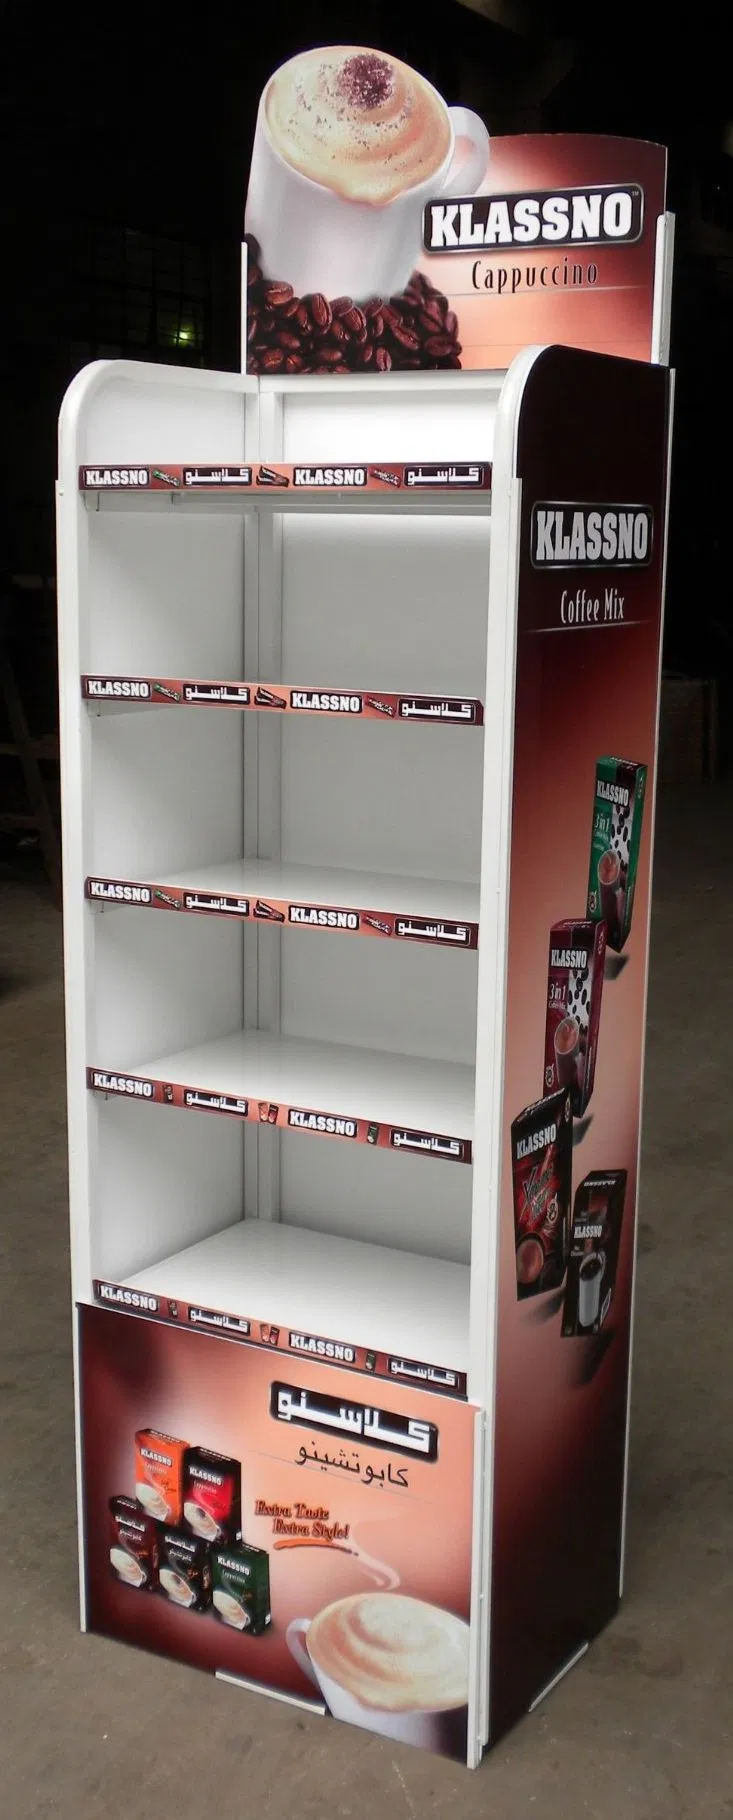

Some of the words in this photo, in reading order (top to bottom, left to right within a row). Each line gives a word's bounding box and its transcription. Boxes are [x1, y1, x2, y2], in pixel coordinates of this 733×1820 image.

[430, 191, 632, 248] KLASSNO
[471, 257, 598, 294] Cappuccino
[85, 470, 148, 485] KLASSNO
[294, 468, 365, 486] KLASSNO
[536, 510, 648, 560] KLASSNO
[560, 589, 600, 624] Coffee
[603, 587, 625, 621] Mix
[87, 680, 149, 697] KLASSNO
[291, 692, 360, 712] KLASSNO
[596, 779, 629, 806] KLASSNO
[90, 881, 151, 903] KLASSNO
[290, 907, 358, 929] KLASSNO
[551, 949, 587, 969] KLASSNO
[549, 983, 554, 999] 3
[555, 982, 561, 1000] in
[94, 1073, 152, 1097] KLASSNO
[289, 1111, 355, 1137] KLASSNO
[516, 1123, 557, 1160] KLASSNO
[574, 1225, 602, 1239] KLASSNO
[100, 1285, 157, 1312] KLASSNO
[290, 1334, 354, 1362] KLASSNO
[277, 1391, 430, 1454] كلاسنو
[141, 1448, 172, 1466] KLASSNO
[294, 1440, 409, 1488] كابوتشينو
[189, 1466, 222, 1485] KLASSNO
[255, 1500, 292, 1518] Extra
[294, 1502, 330, 1521] Taste
[272, 1518, 310, 1537] Extra
[217, 1555, 250, 1576] KLASSNO
